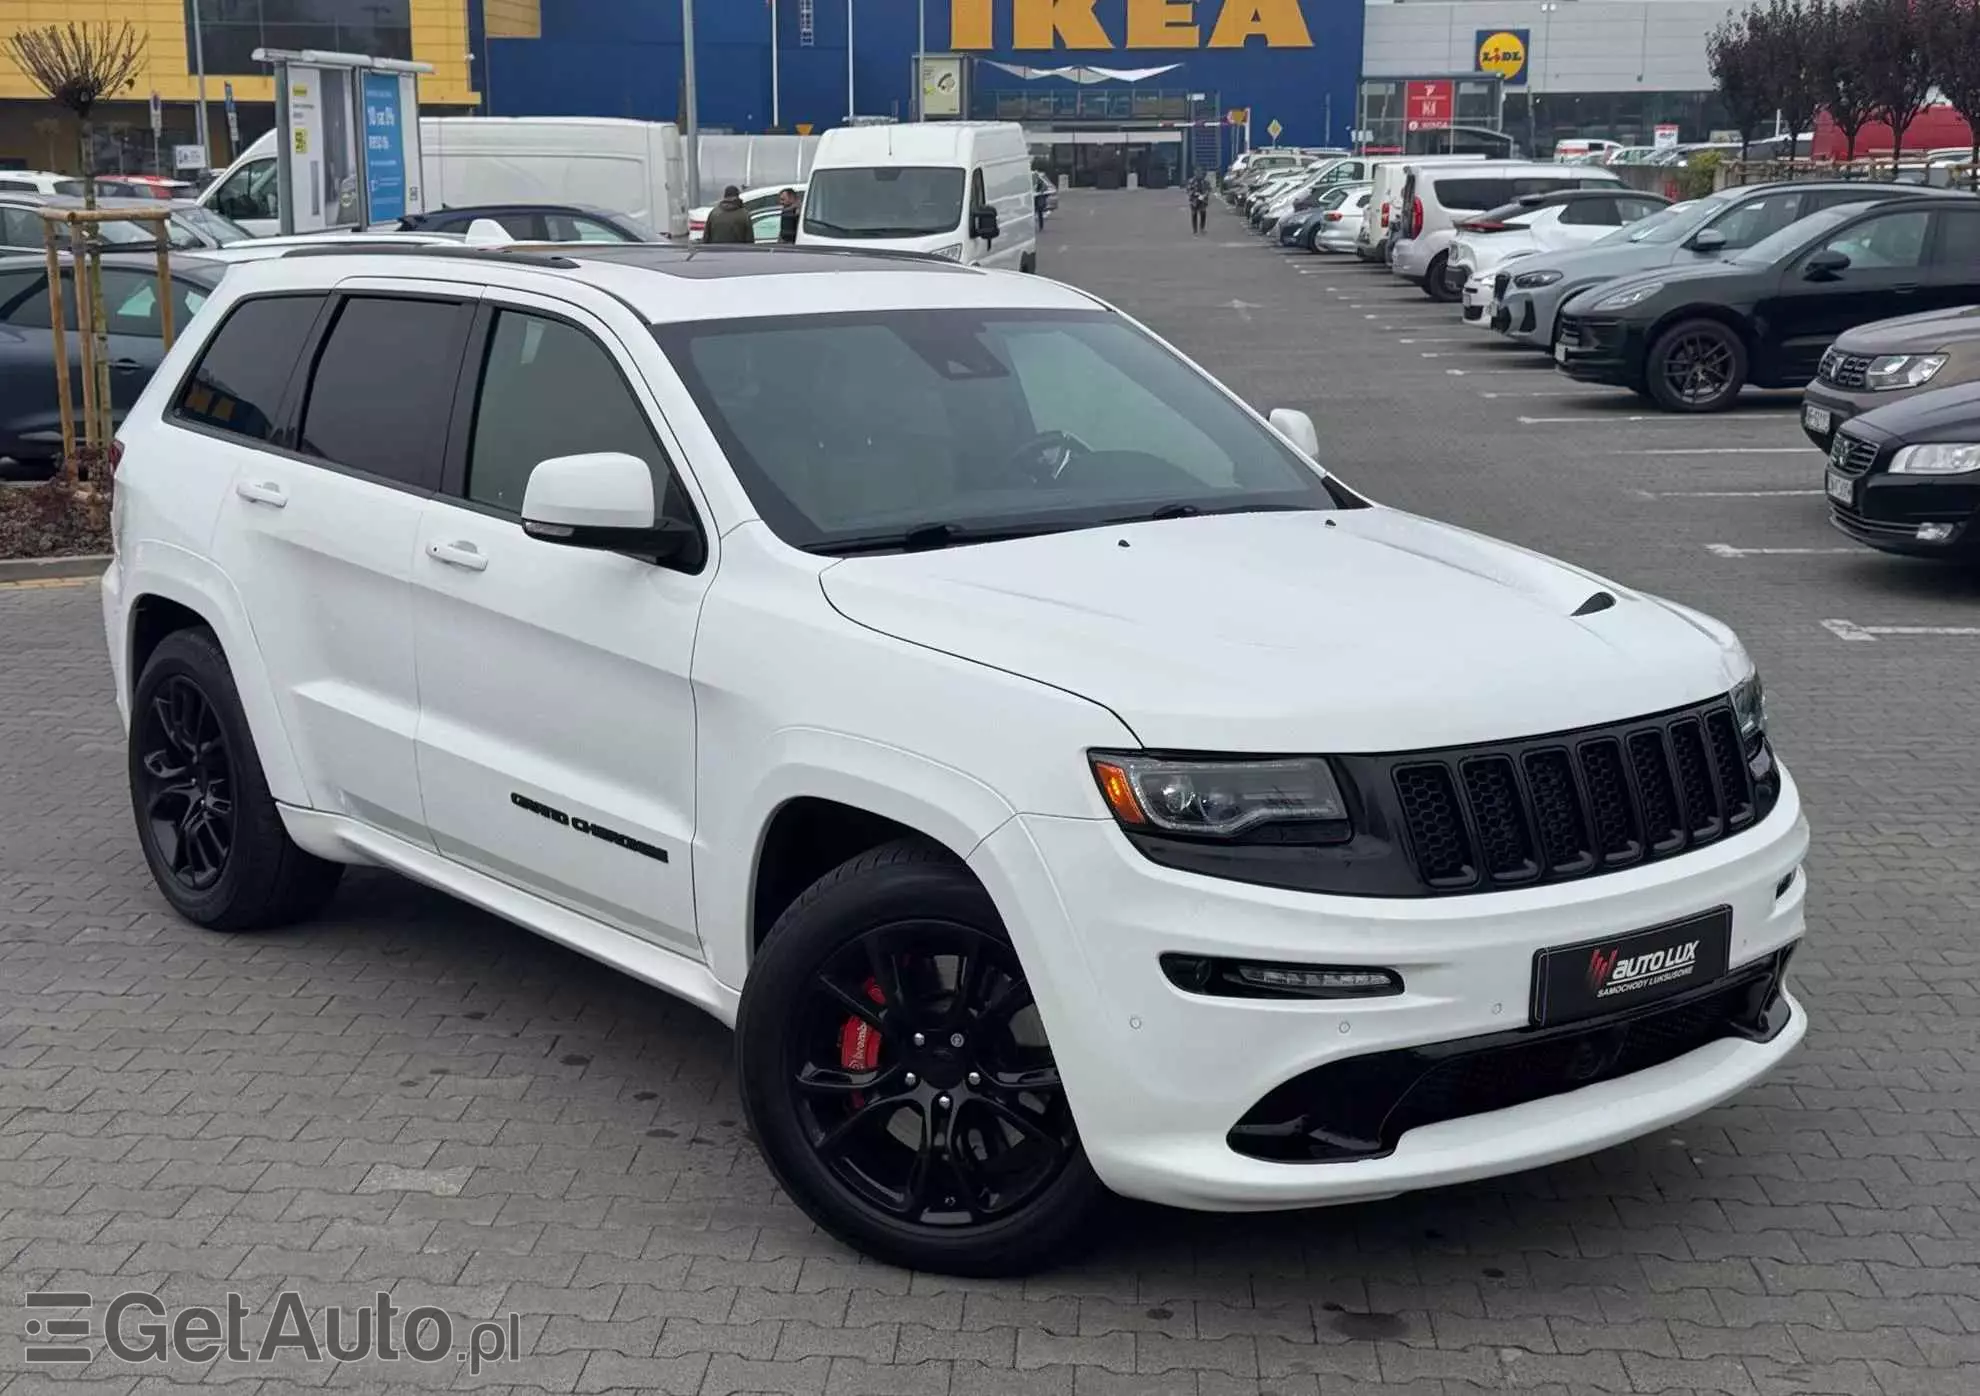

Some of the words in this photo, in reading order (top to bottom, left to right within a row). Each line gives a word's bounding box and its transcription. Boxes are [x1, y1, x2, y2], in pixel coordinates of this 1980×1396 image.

[950, 0, 1314, 49] IKEA
[571, 816, 669, 863] CHERO
[1664, 940, 1700, 966] LUX
[1597, 978, 1650, 998] SAMOCHODY
[852, 1021, 867, 1060] bremb
